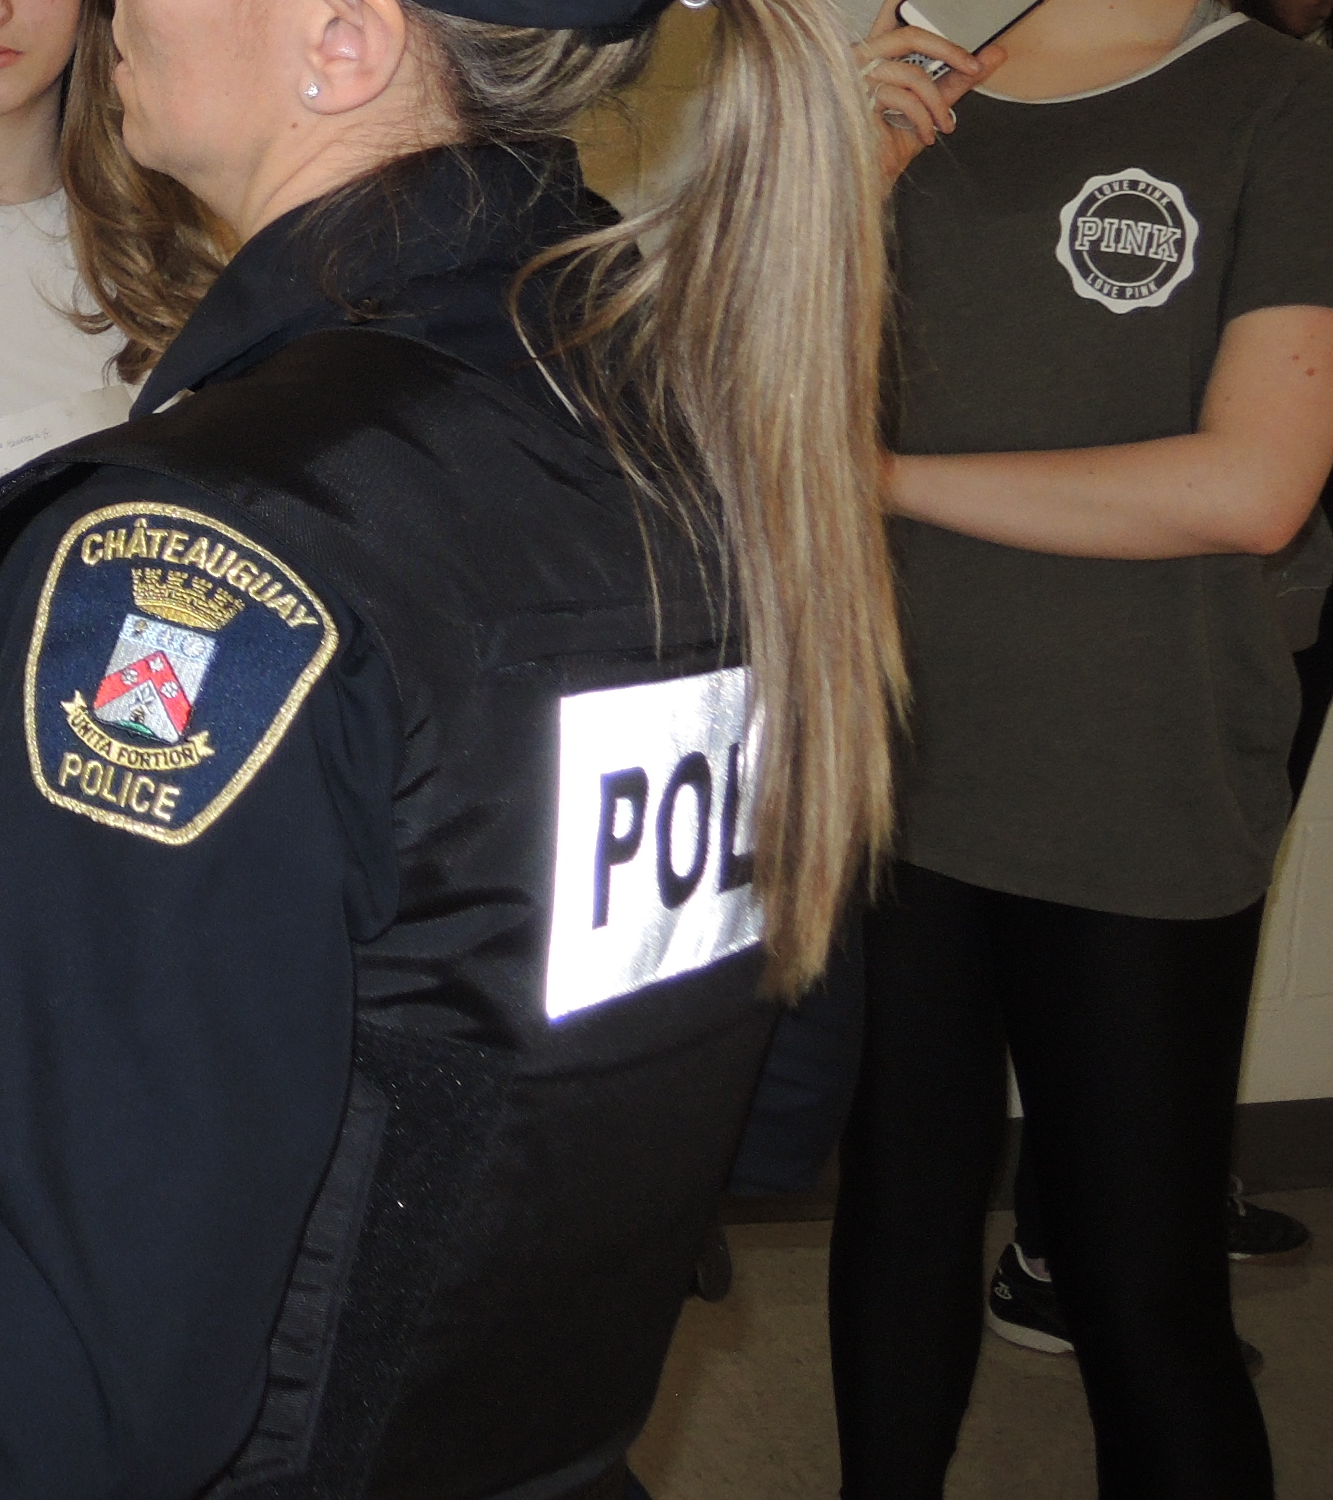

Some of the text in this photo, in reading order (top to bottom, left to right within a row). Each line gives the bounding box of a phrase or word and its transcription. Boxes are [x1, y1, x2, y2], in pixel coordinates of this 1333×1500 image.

[1094, 181, 1171, 206] LOVE PINK
[1075, 217, 1182, 262] PINK
[1086, 273, 1159, 299] LOVE PINK
[81, 517, 318, 629] CHÂTEAUGUAY
[58, 752, 181, 823] POLICE
